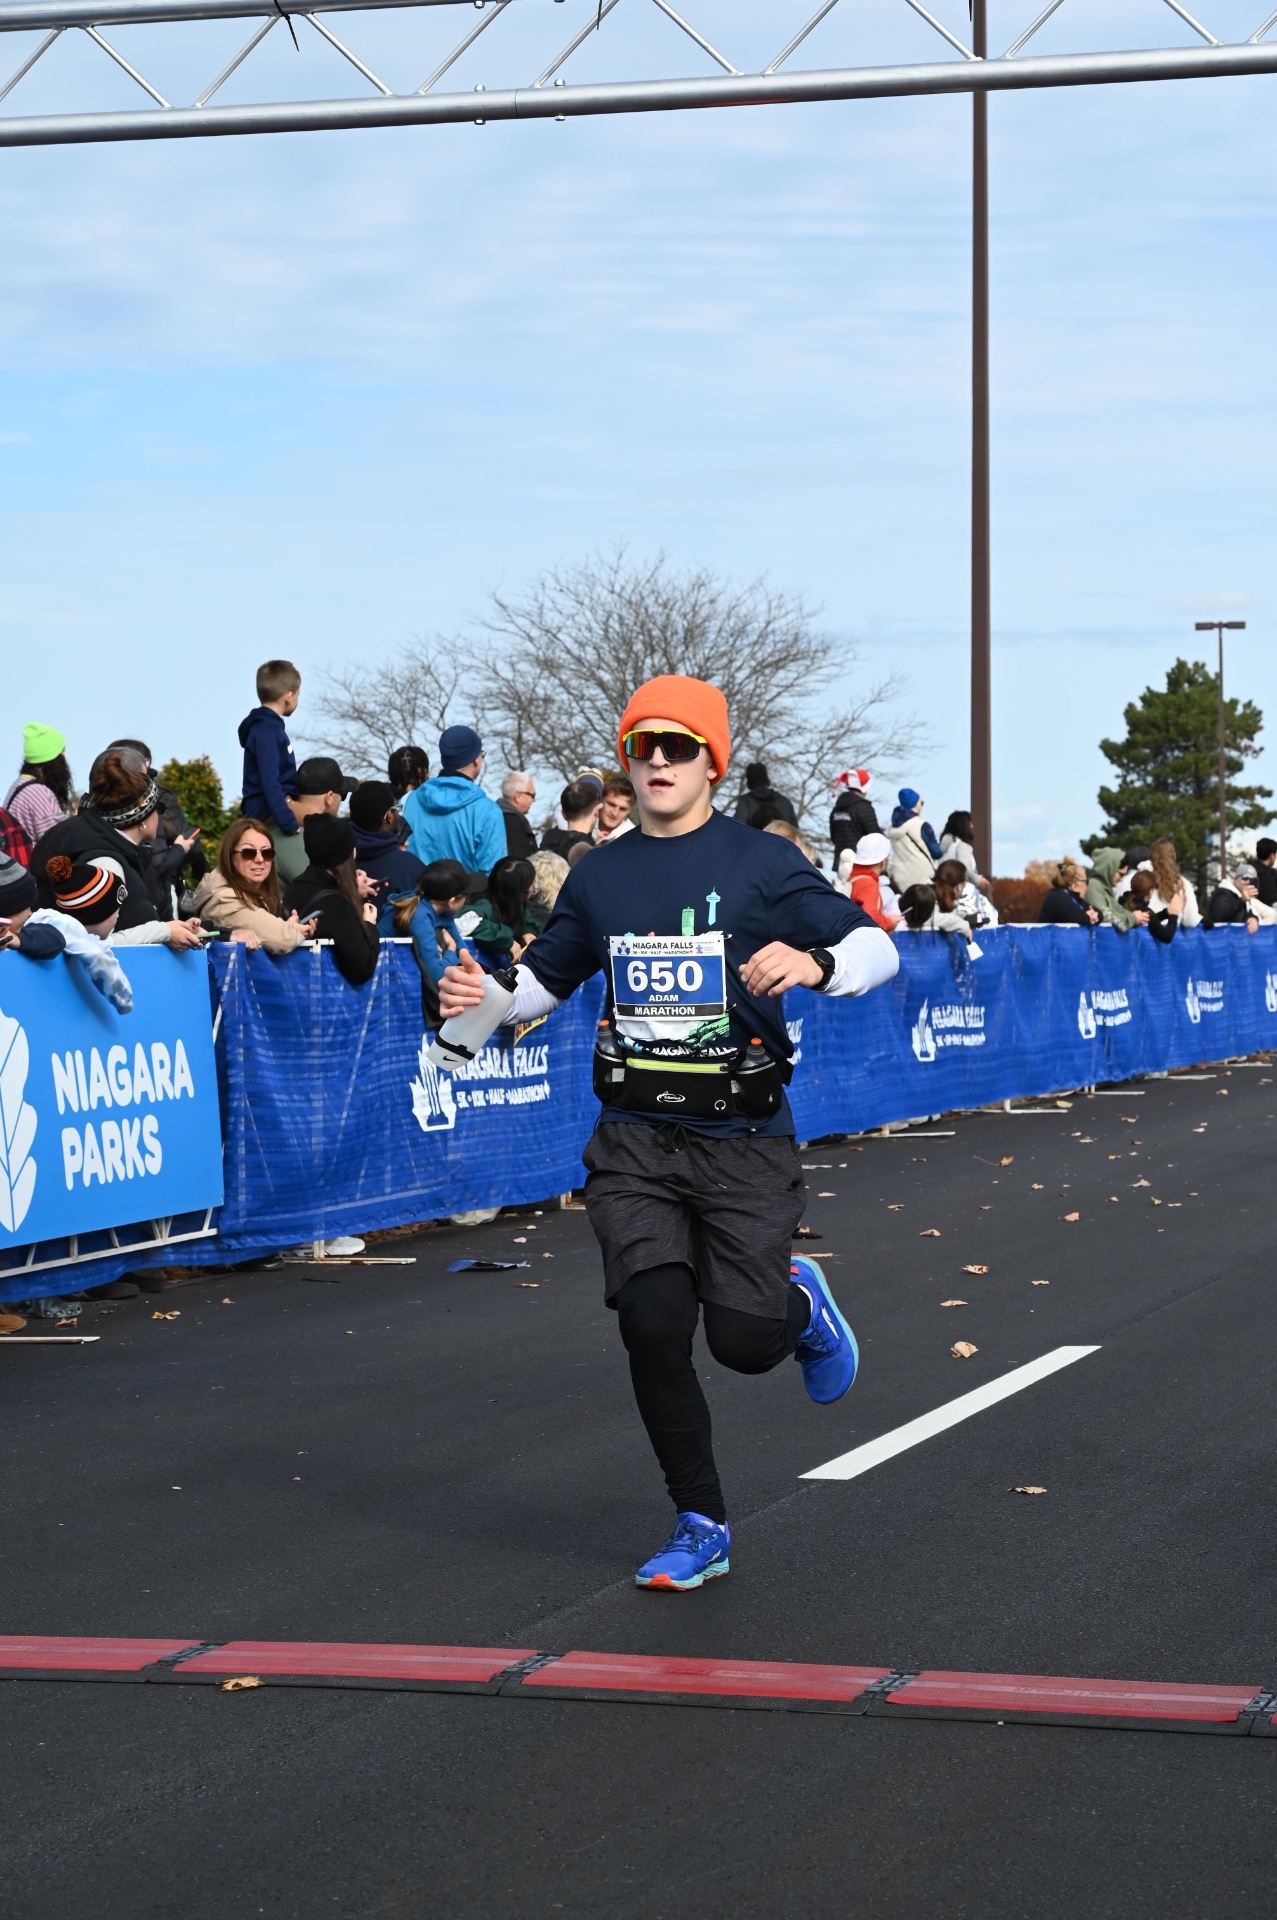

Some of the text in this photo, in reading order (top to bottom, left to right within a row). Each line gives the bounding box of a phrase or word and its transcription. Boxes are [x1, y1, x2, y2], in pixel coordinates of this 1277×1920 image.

[627, 960, 704, 992] 650
[634, 1006, 696, 1016] MARATHON
[648, 994, 679, 1002] ADAM
[51, 1038, 195, 1115] NIAGARA
[513, 1044, 549, 1078] FALLS
[456, 1083, 546, 1109] 5K 10K HALF MARATHON
[61, 1114, 163, 1191] PARKS
